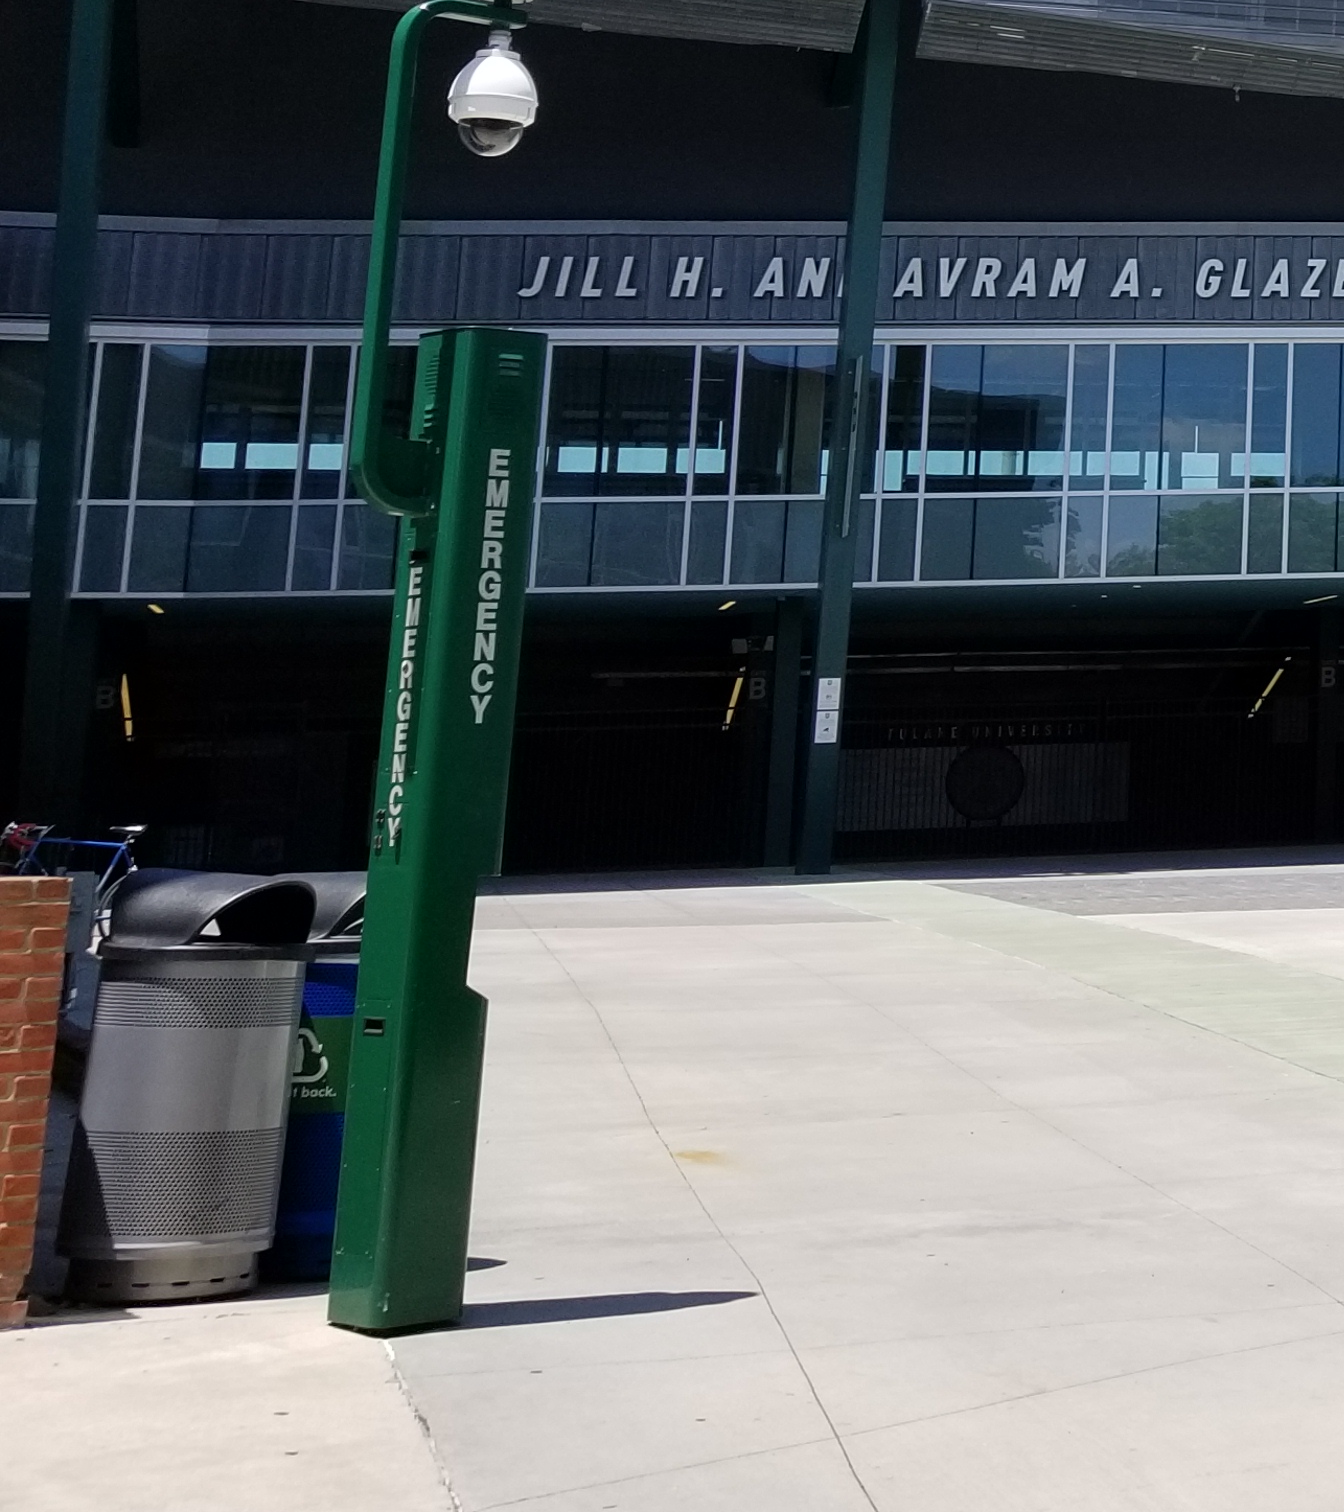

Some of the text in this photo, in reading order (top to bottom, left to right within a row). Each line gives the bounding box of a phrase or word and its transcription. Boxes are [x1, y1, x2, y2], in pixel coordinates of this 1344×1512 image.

[517, 256, 637, 298] JILL
[669, 257, 723, 298] H.
[753, 257, 843, 298] AN
[893, 257, 1086, 298] AVRAM
[1110, 258, 1163, 298] A.
[470, 448, 511, 724] EMERGENCY
[95, 685, 115, 709] B
[749, 676, 766, 700] B
[387, 566, 423, 847] EMERGENCY
[301, 1086, 337, 1098] back.
